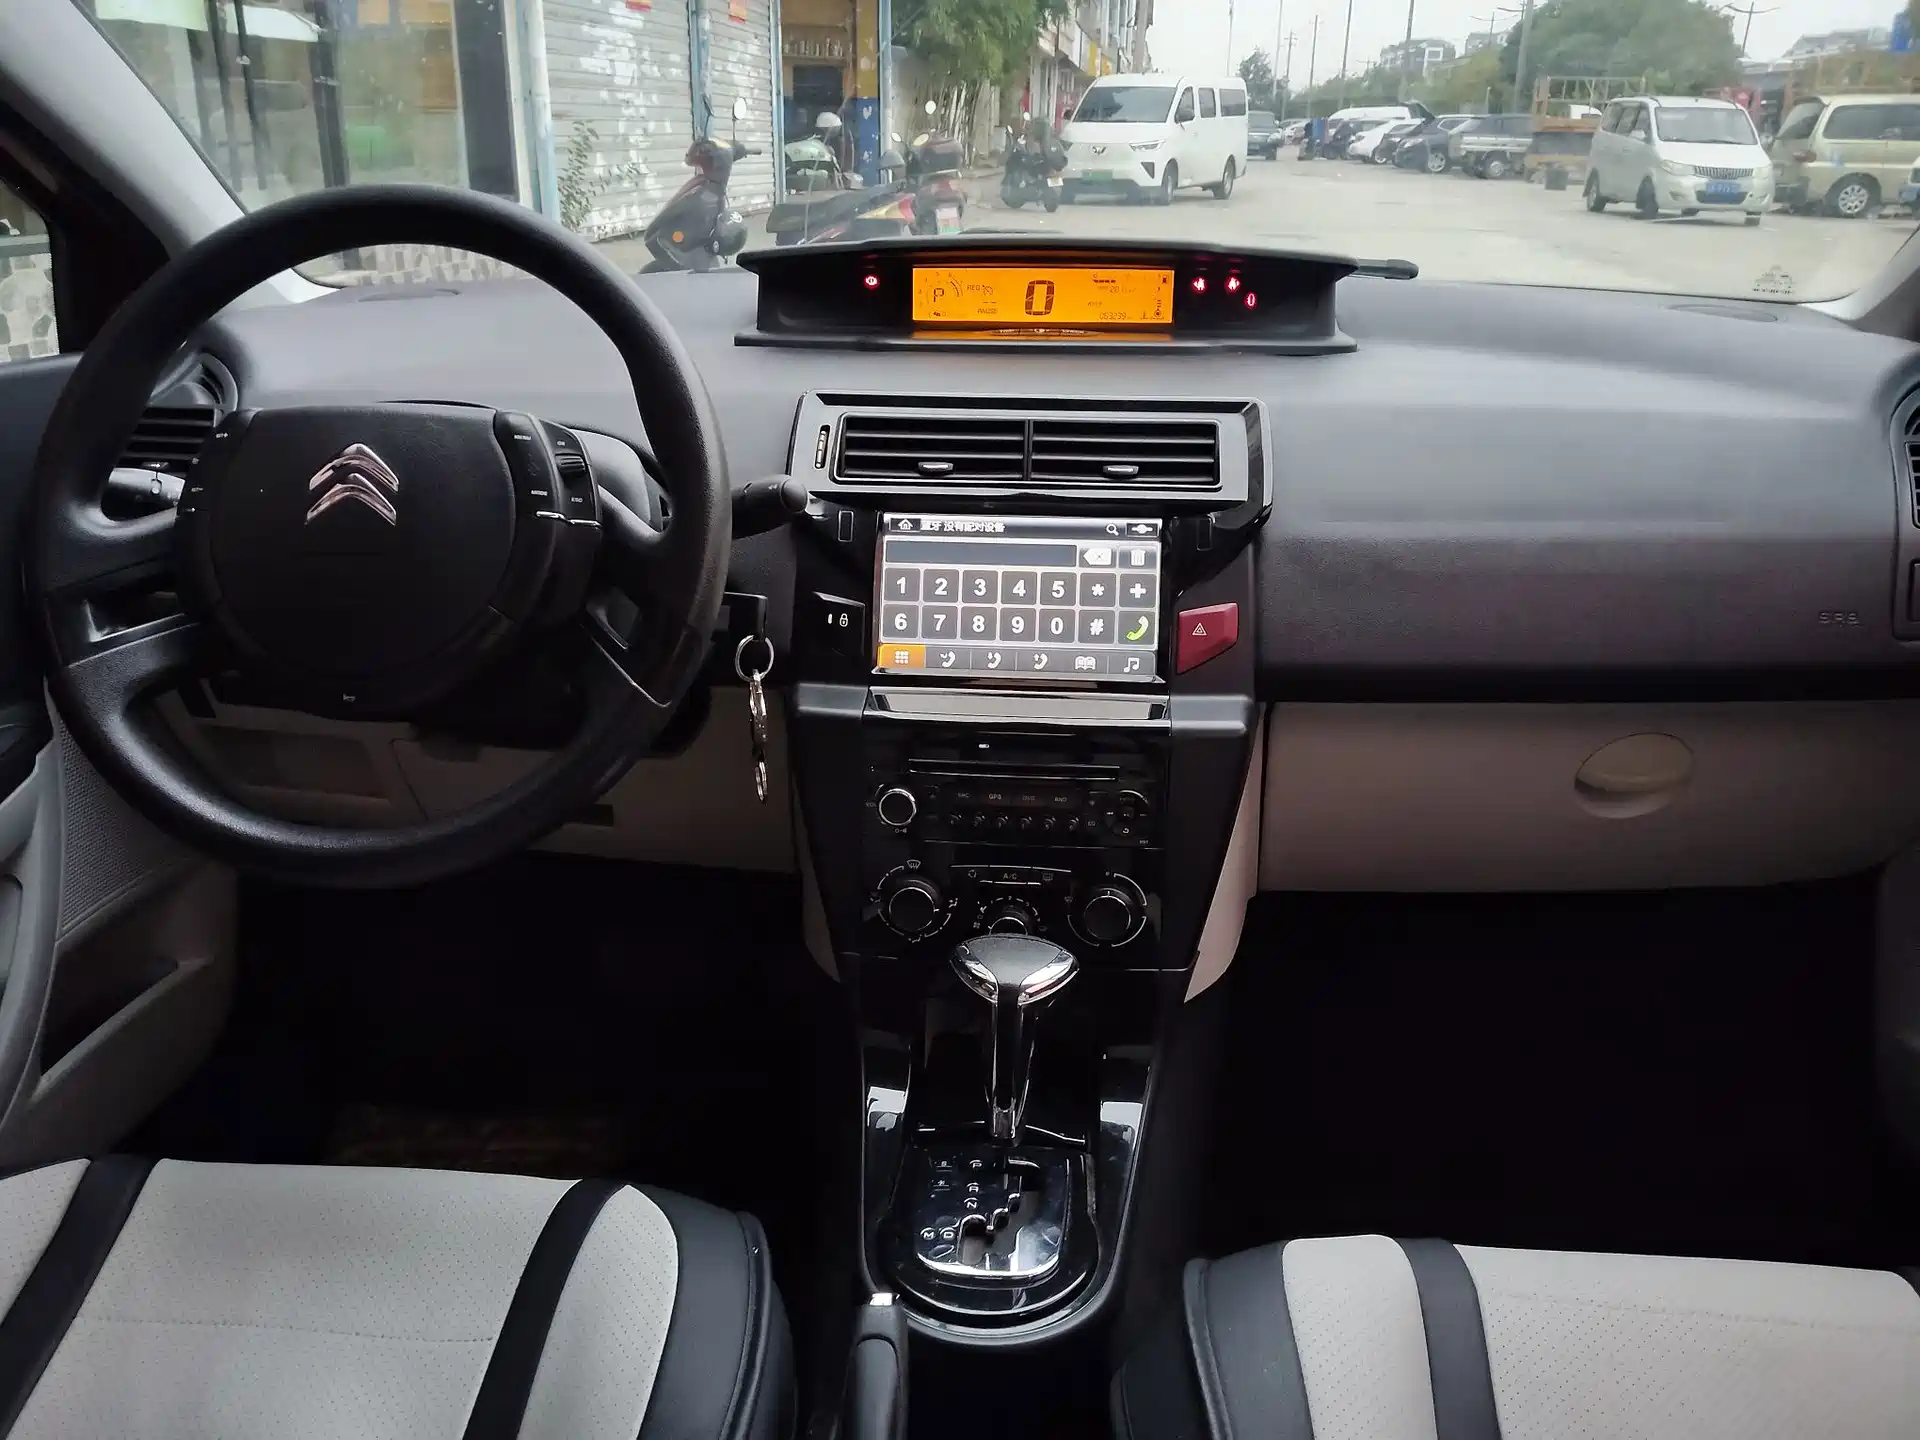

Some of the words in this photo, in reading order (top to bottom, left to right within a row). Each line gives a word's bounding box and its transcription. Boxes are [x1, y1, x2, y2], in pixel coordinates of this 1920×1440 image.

[933, 288, 945, 302] P
[1025, 280, 1055, 316] 0
[943, 521, 1005, 532] 没有配对设备
[897, 577, 905, 593] 1
[935, 578, 947, 595] 2
[974, 579, 986, 595] 3
[1013, 580, 1026, 596] 4
[1052, 581, 1064, 597] 5
[895, 613, 907, 630] 6
[934, 615, 946, 630] 7
[973, 616, 984, 632] 8
[1012, 617, 1024, 633] 9
[1051, 618, 1063, 634] 0
[1090, 619, 1103, 635] #
[923, 1231, 935, 1239] M
[943, 1231, 954, 1239] D
